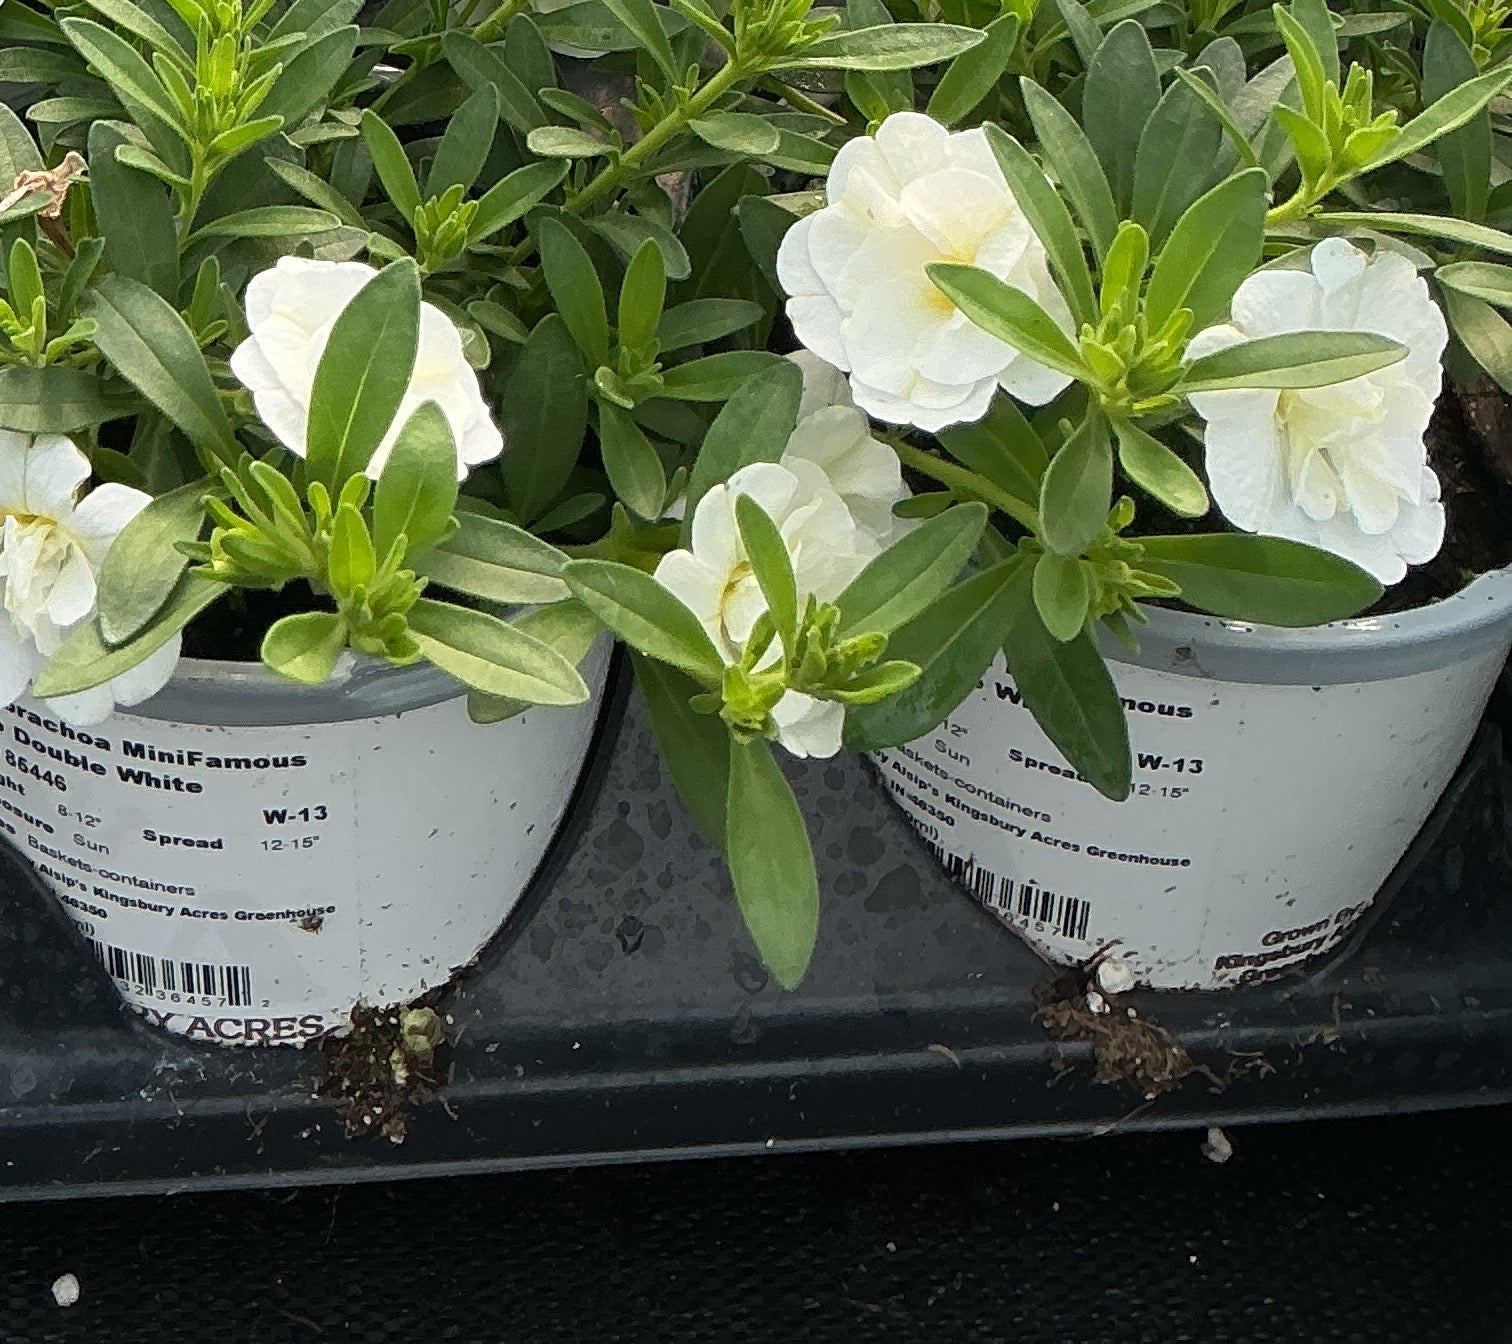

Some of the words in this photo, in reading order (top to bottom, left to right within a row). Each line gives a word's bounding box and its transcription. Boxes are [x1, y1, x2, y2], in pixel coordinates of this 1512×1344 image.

[4, 702, 112, 753] rachoa
[122, 739, 308, 770] MiniFamous
[13, 725, 107, 776] Double
[116, 765, 204, 794] White
[934, 739, 971, 767] Sun
[1137, 752, 1203, 775] W-13
[897, 744, 1052, 823] skets-containers
[262, 805, 329, 825] W-13
[945, 793, 1027, 838] Kingsbury
[1030, 830, 1080, 852] Acres
[1086, 845, 1191, 868] Greenhouse
[72, 832, 110, 856] Sun
[142, 828, 224, 850] Spread
[27, 833, 196, 897] Baskets-containers
[93, 885, 175, 917] Kingsbury
[179, 906, 228, 921] Acres
[234, 903, 336, 921] Greenhouse
[187, 1014, 325, 1041] ACRES
